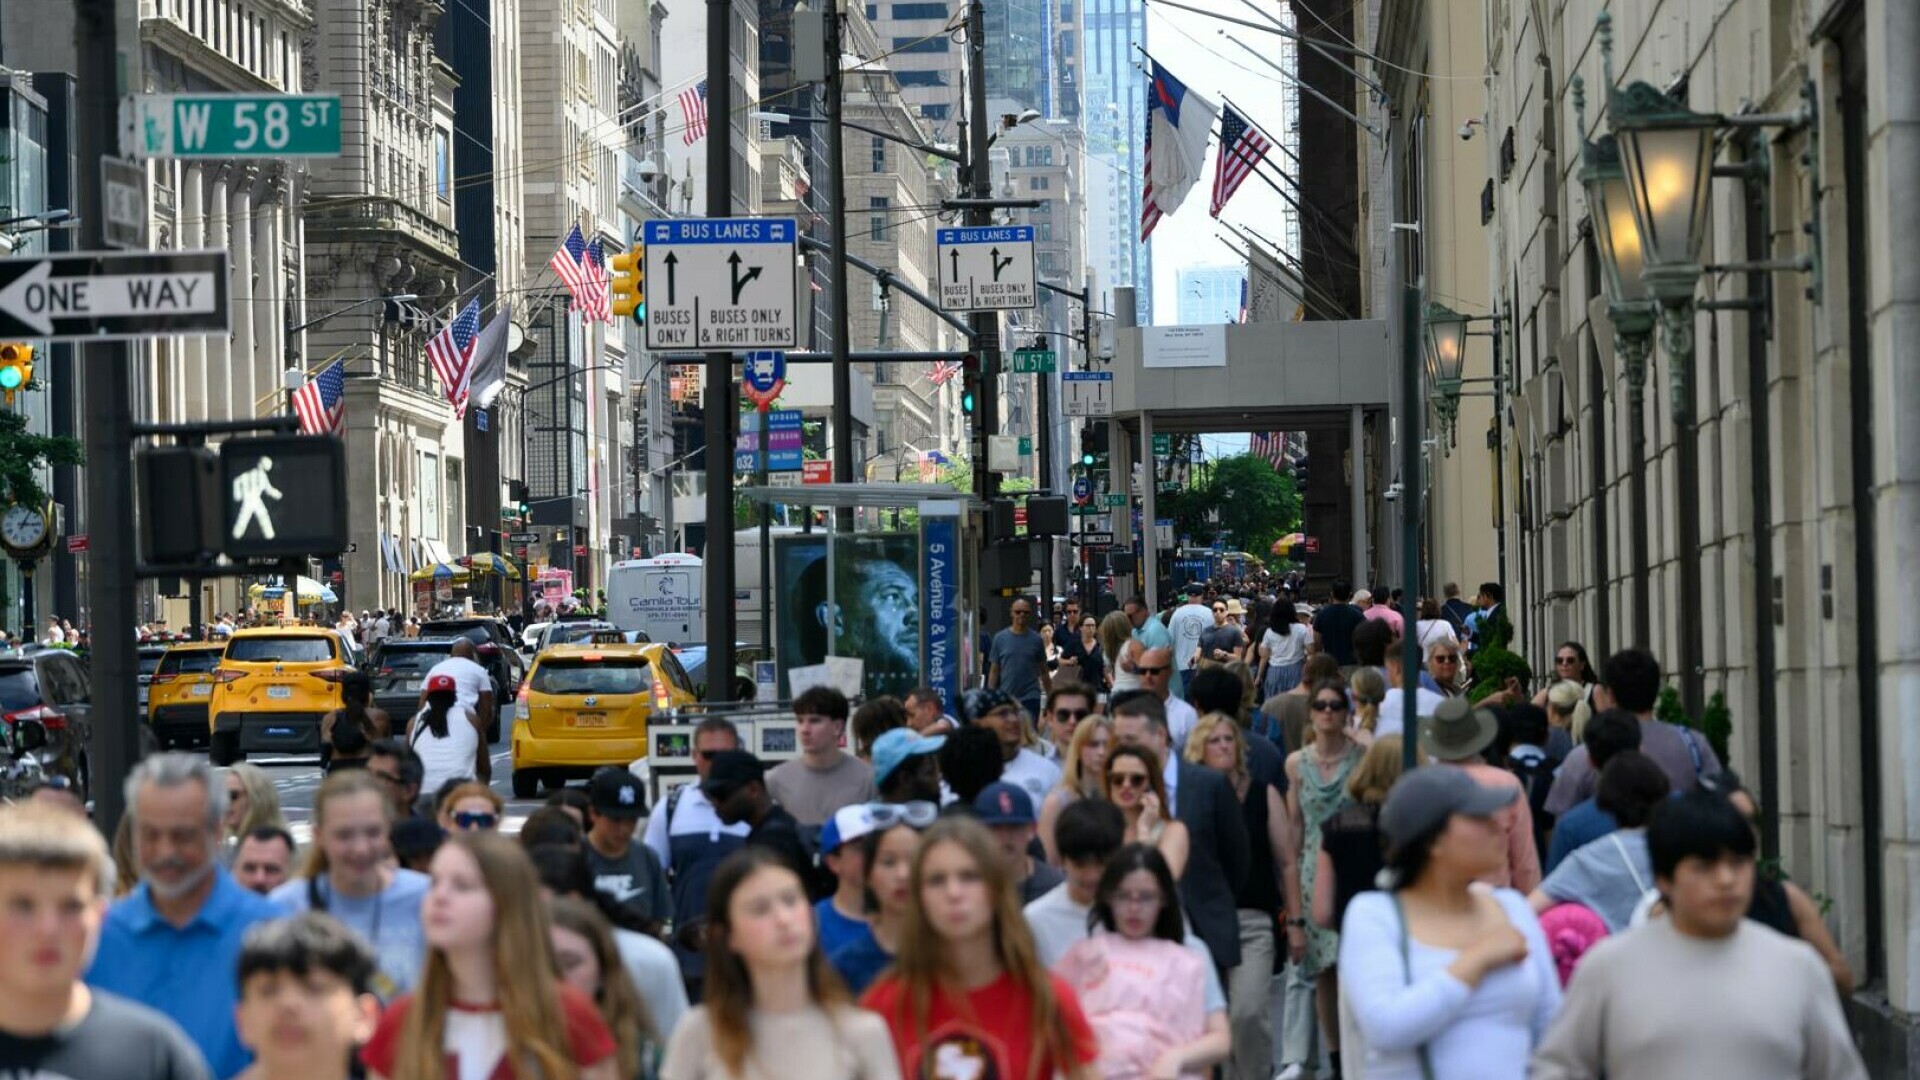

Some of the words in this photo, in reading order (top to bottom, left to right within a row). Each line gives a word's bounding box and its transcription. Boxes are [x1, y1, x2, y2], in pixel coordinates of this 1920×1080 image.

[177, 103, 211, 149] W
[234, 102, 289, 148] 58
[301, 102, 331, 127] ST
[681, 223, 710, 238] BUS
[715, 223, 760, 238] LANES
[961, 230, 979, 241] BUS
[982, 229, 1011, 240] LANES
[944, 285, 968, 296] BUSES
[980, 284, 1004, 294] BUSES
[1007, 283, 1026, 293] ONLY
[25, 281, 90, 314] ONE
[128, 279, 198, 308] WAY
[947, 298, 966, 307] ONLY
[975, 297, 981, 306] &
[983, 296, 1006, 305] RIGHT
[1007, 295, 1032, 305] TURNS
[654, 310, 690, 325] BUSES
[711, 309, 747, 324] BUSES
[752, 309, 781, 323] ONLY
[658, 329, 687, 343] ONLY
[702, 328, 710, 342] &
[716, 328, 749, 342] RIGHT
[754, 327, 791, 341] TURNS
[1014, 353, 1025, 370] W
[1031, 353, 1042, 370] 57
[930, 543, 945, 553] 5
[930, 558, 945, 620] Avenue
[629, 597, 673, 606] Camila
[930, 624, 946, 635] &
[930, 640, 946, 682] West
